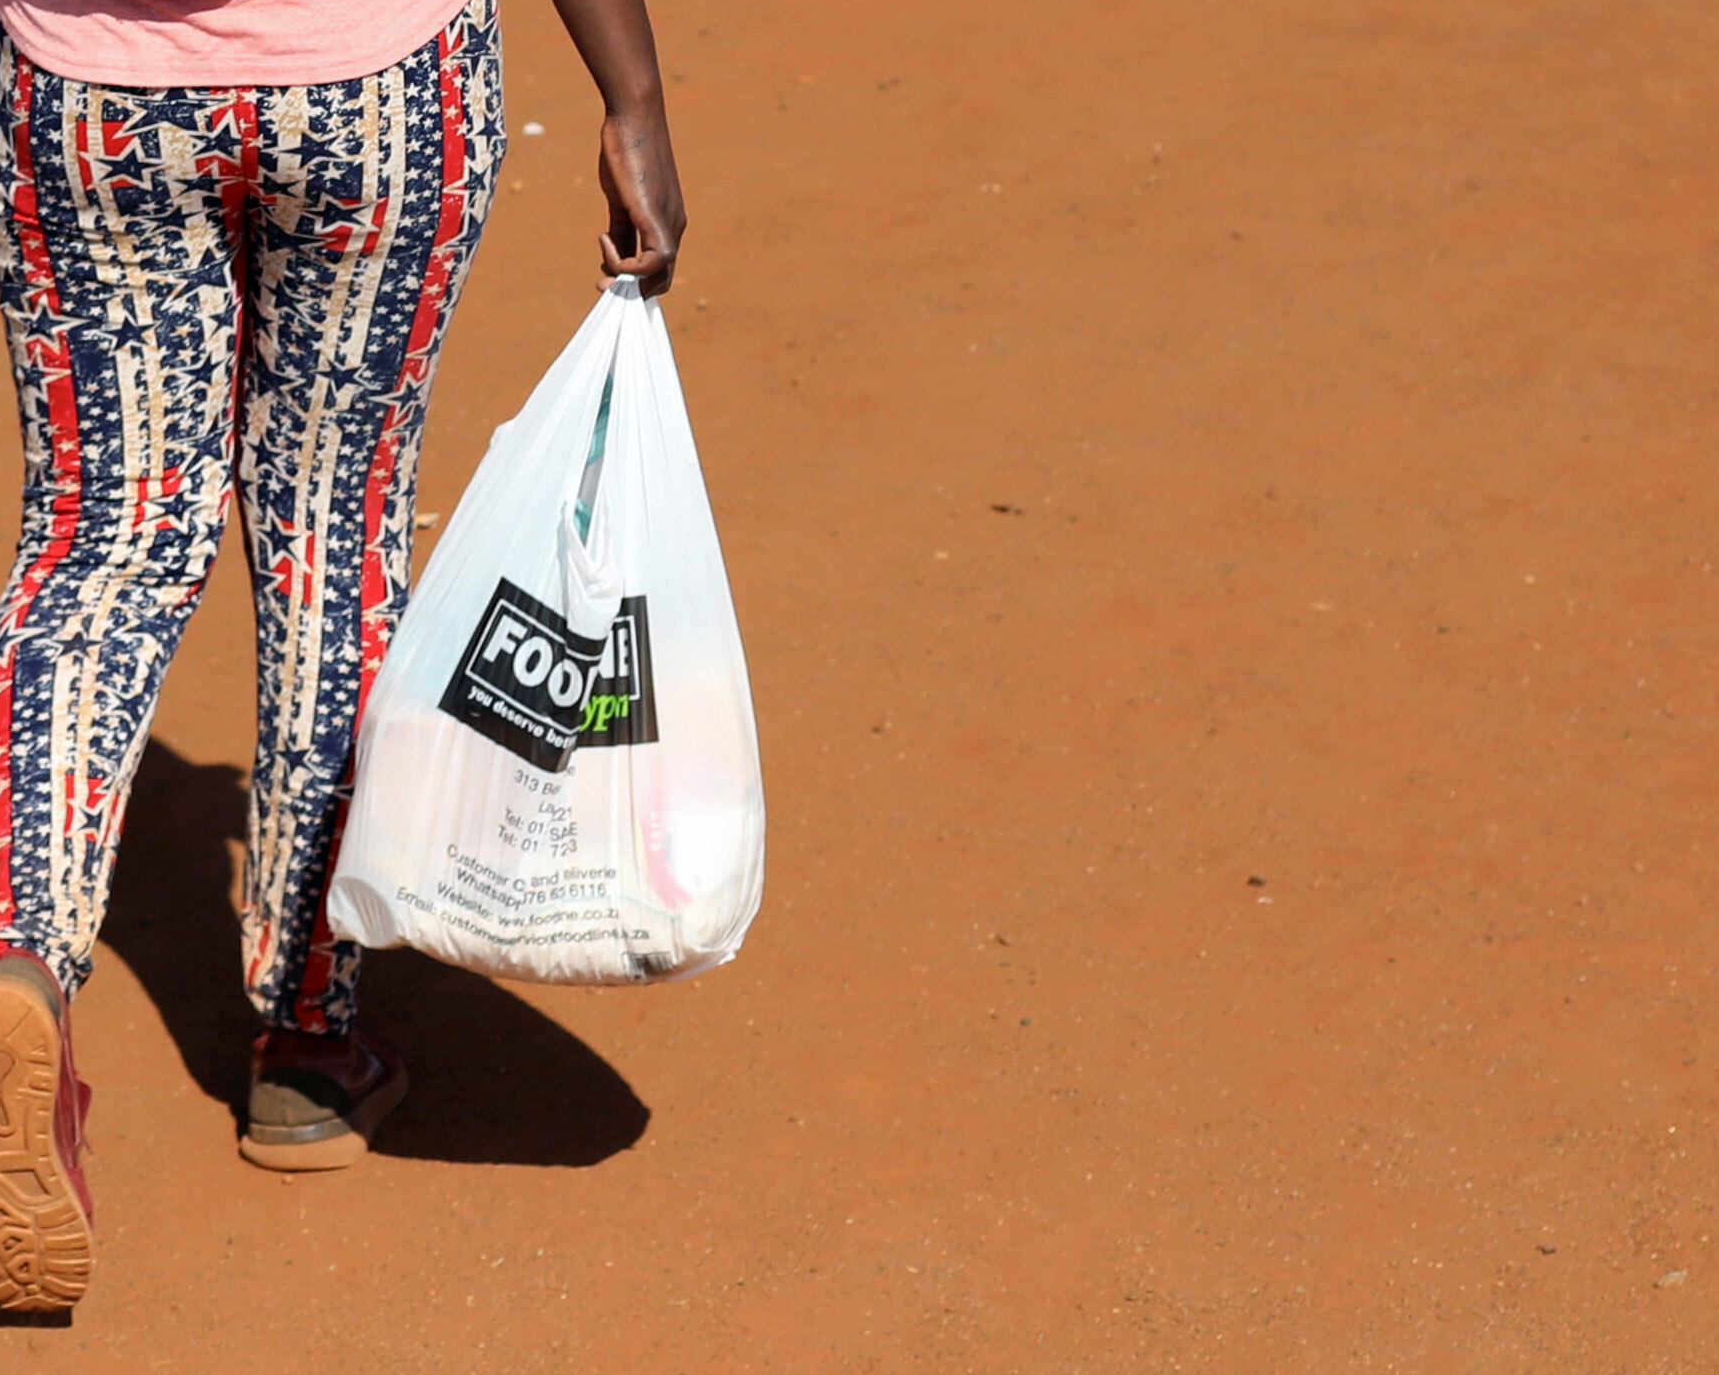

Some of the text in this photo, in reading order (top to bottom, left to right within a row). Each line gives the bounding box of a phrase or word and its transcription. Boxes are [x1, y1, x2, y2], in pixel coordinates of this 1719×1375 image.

[483, 614, 598, 711] FOO
[468, 685, 492, 706] you
[493, 700, 544, 737] deserve
[514, 769, 539, 792] 313
[498, 824, 518, 848] Tel:
[521, 837, 539, 852] 01
[504, 806, 524, 830] Tel:
[527, 820, 545, 834] 01
[447, 843, 509, 886] Customer
[531, 868, 559, 888] and
[396, 885, 437, 915] Email:
[437, 880, 493, 922] Website:
